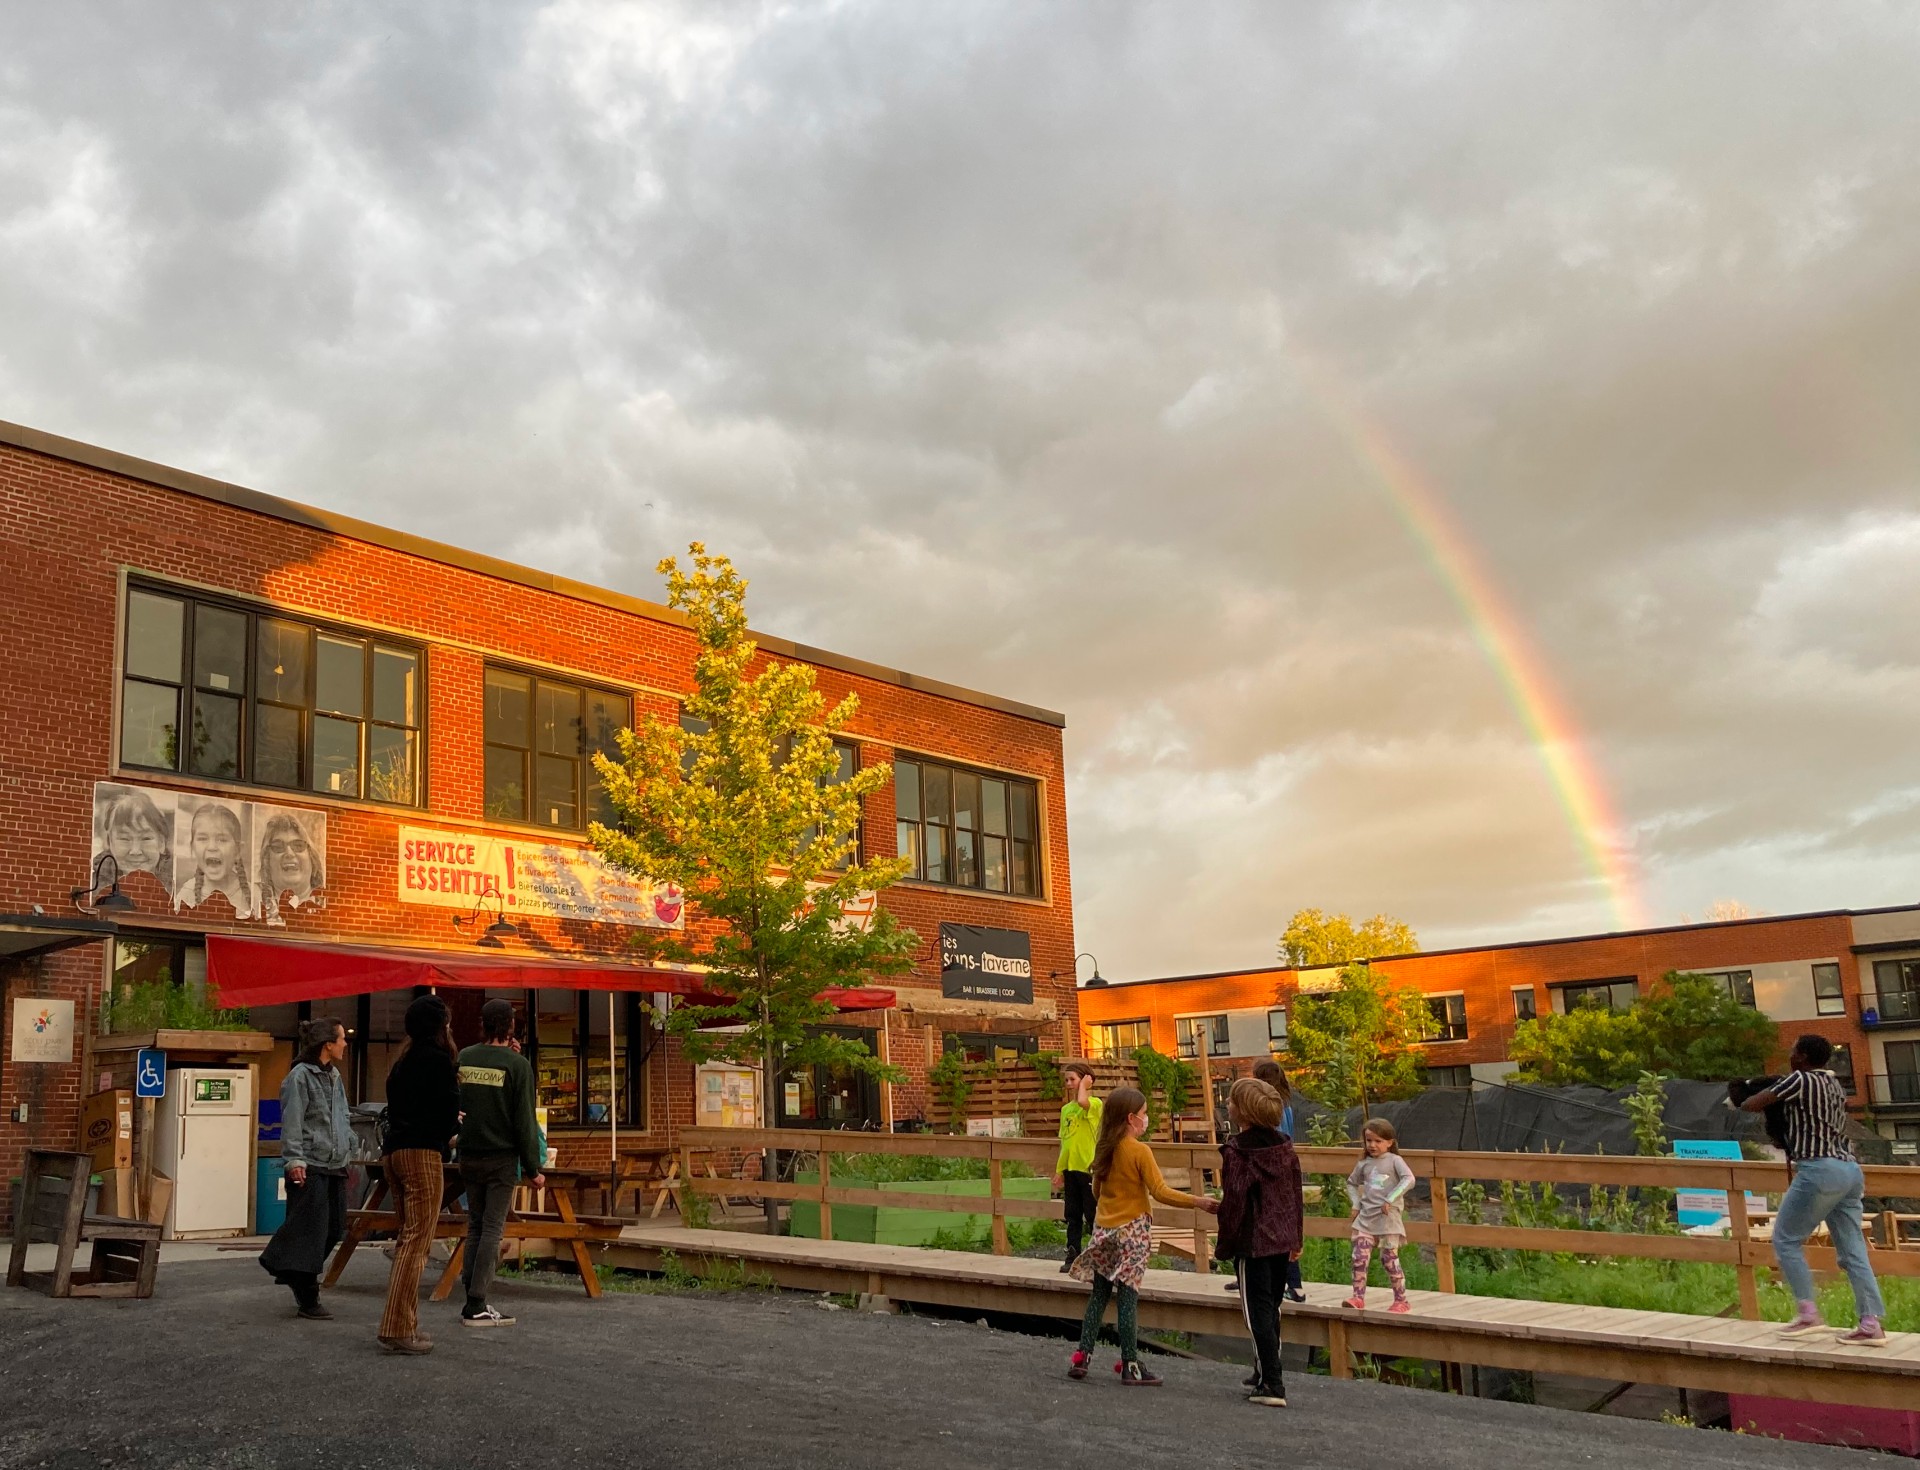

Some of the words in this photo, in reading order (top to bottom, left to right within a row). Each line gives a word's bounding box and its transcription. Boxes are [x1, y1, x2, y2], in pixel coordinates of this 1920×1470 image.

[404, 839, 475, 865] SERVICE
[560, 856, 589, 867] quartier
[517, 866, 522, 875] &
[405, 864, 504, 899] ESSENTIEL
[518, 881, 542, 892] Bières
[542, 883, 569, 896] locales
[570, 886, 576, 896] &
[518, 896, 541, 908] pizzas
[542, 901, 560, 911] pour
[561, 902, 596, 914] emporter
[943, 934, 957, 949] les
[962, 985, 972, 994] BAR
[976, 986, 998, 995] BRASSERIE
[1002, 988, 1015, 996] COOP
